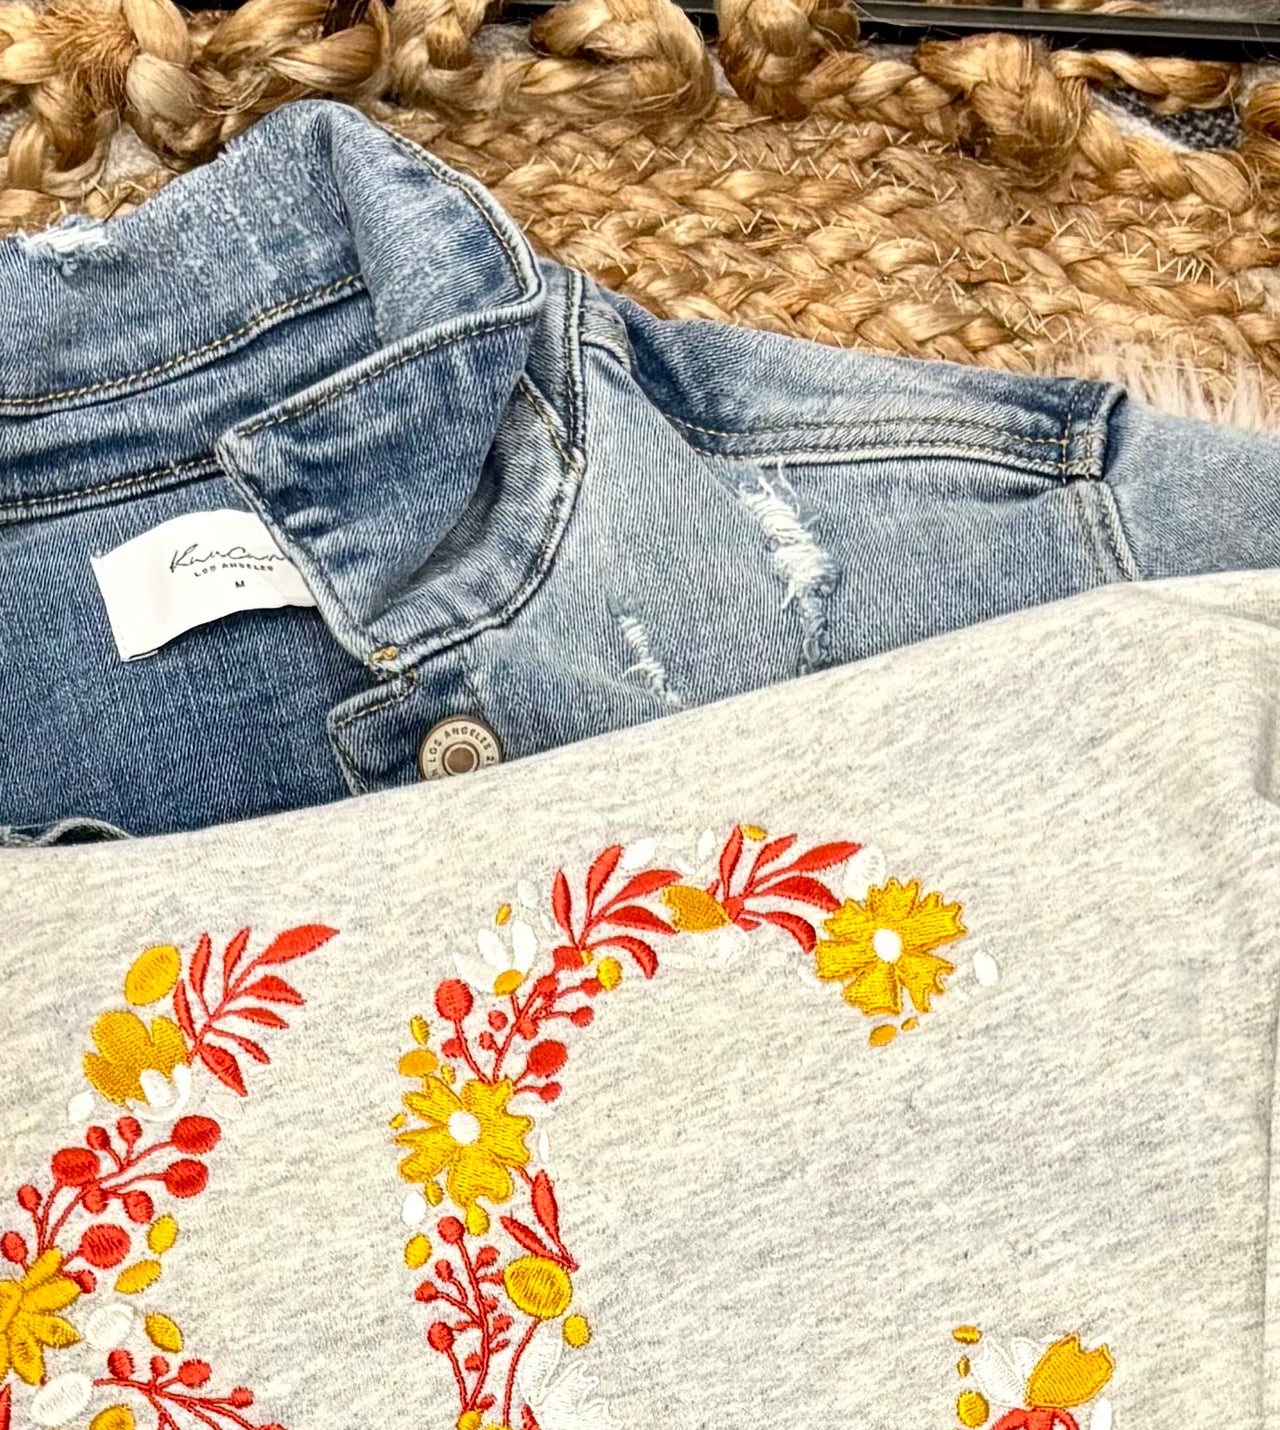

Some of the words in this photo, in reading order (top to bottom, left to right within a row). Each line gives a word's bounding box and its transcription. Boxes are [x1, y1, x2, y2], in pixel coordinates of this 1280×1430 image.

[194, 565, 217, 577] LOS
[221, 561, 275, 572] ANGELES
[234, 579, 246, 589] M
[428, 739, 442, 763] LOS
[444, 726, 492, 751] ANGELES
